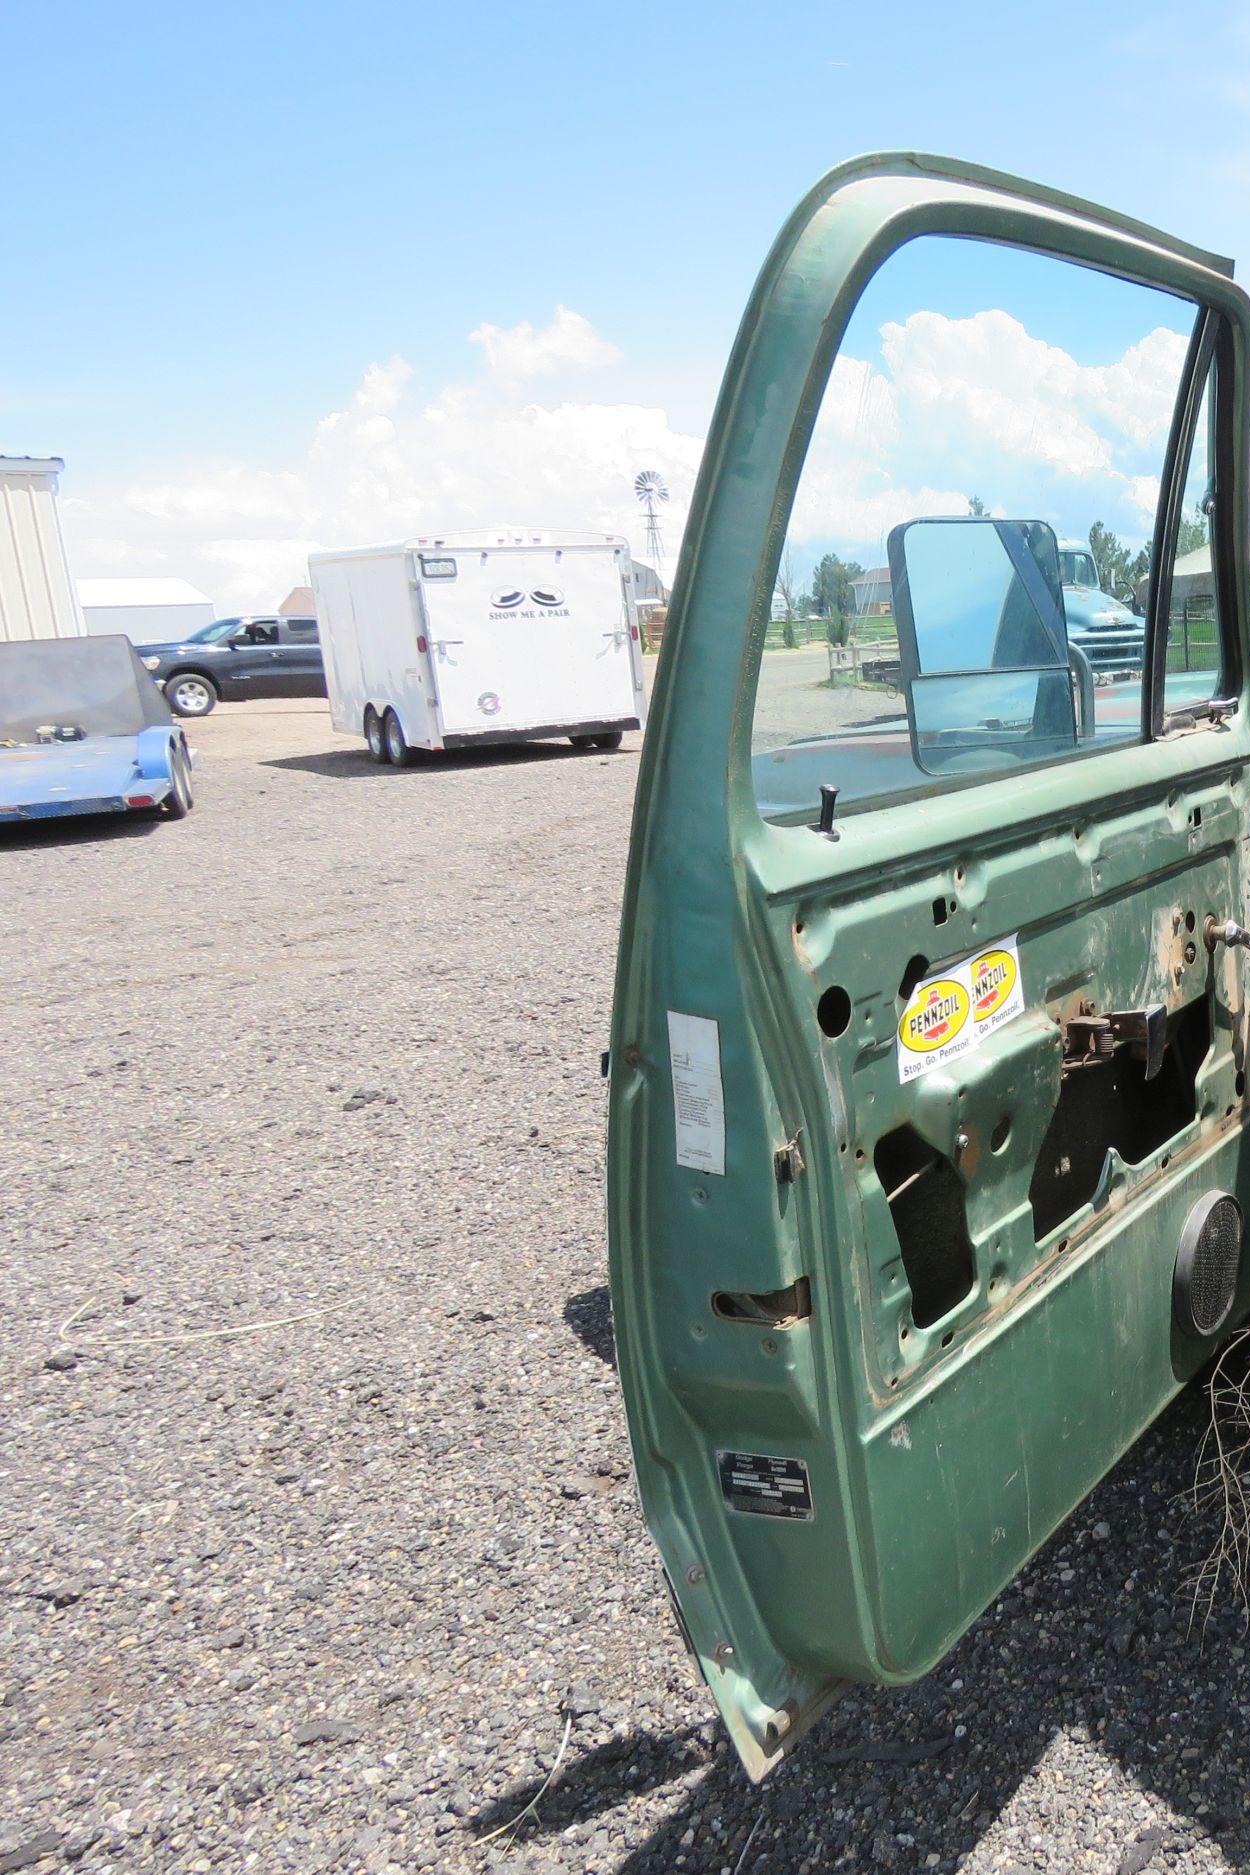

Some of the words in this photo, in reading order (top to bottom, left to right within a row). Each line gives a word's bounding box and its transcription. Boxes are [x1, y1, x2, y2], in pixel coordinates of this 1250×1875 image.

[488, 611, 518, 620] SHOW
[520, 610, 536, 619] ME
[538, 610, 546, 618] A
[547, 609, 571, 618] PAIR
[909, 994, 960, 1038] PENNZOIL
[903, 1061, 924, 1077] Stop.
[925, 1055, 938, 1066] Go.
